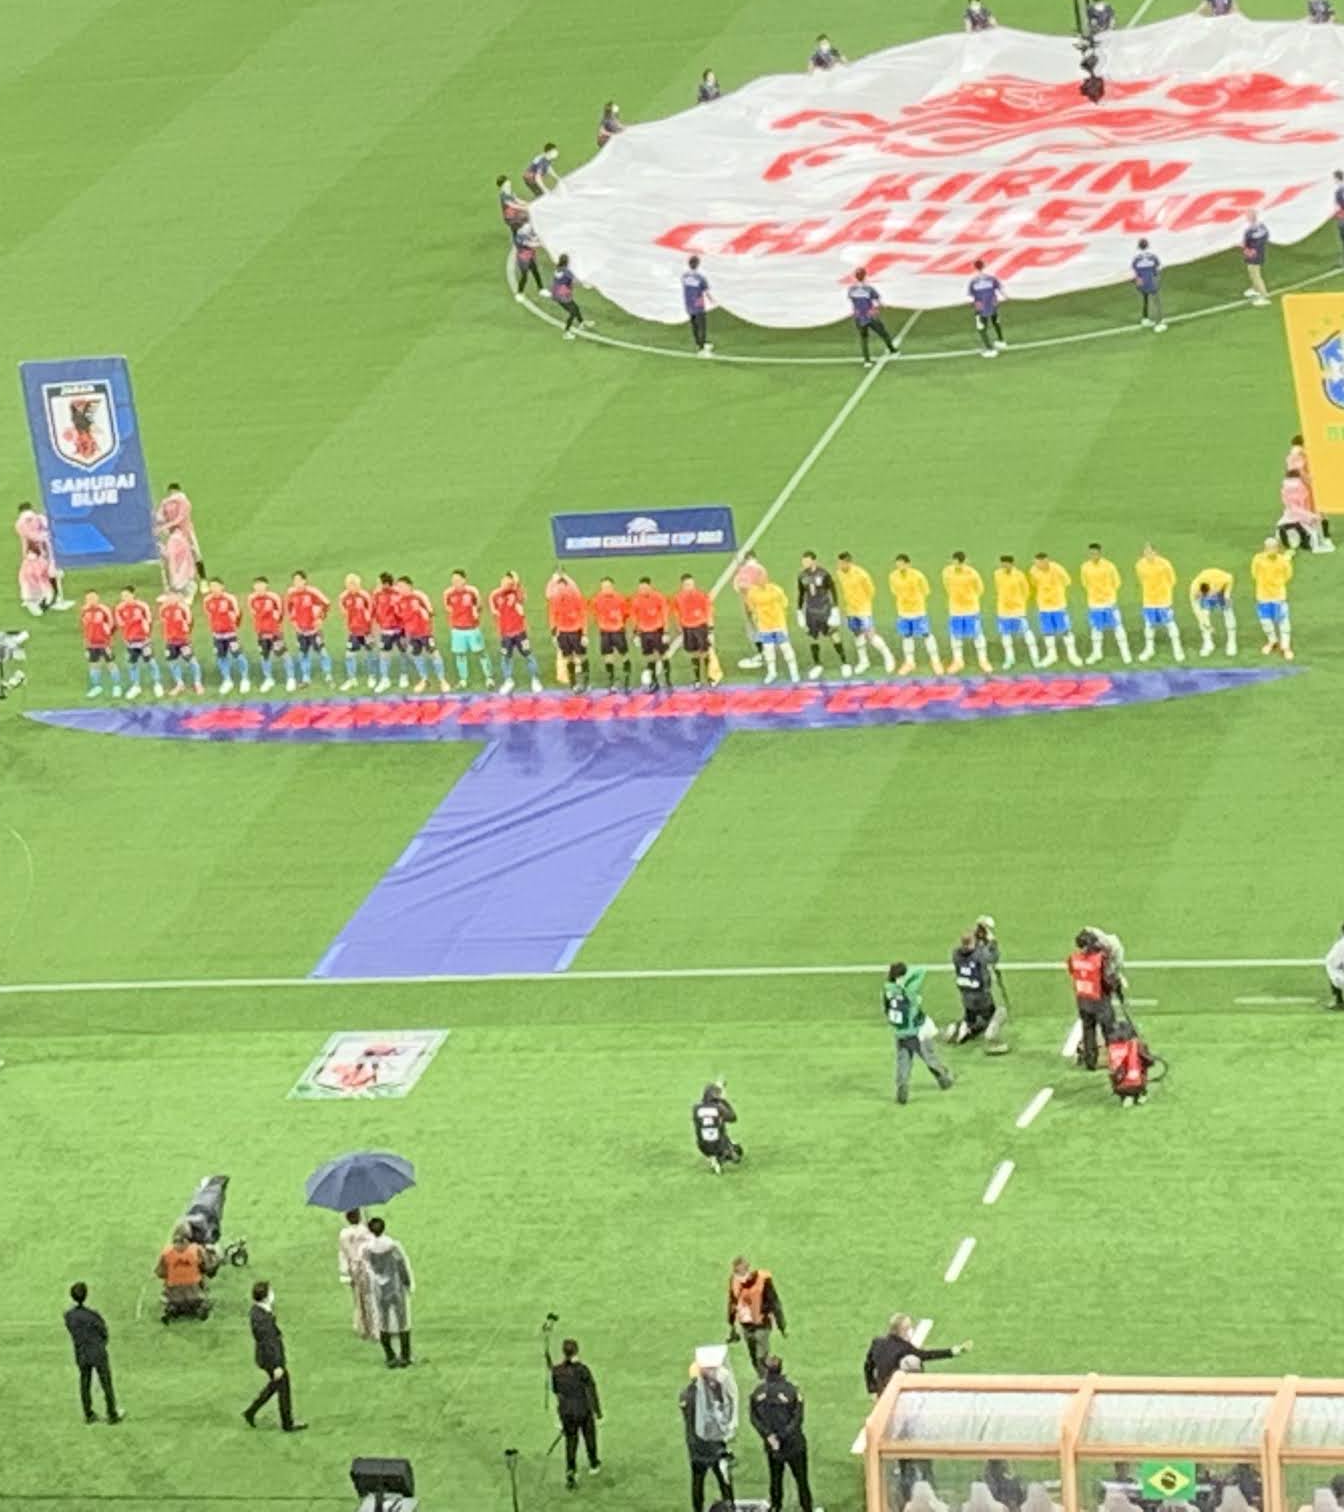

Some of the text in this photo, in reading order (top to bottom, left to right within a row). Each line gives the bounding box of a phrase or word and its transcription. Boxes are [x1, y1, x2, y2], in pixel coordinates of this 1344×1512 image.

[840, 159, 1193, 211] KIRIN
[50, 473, 136, 495] SAMURAI
[71, 489, 119, 507] BLUE
